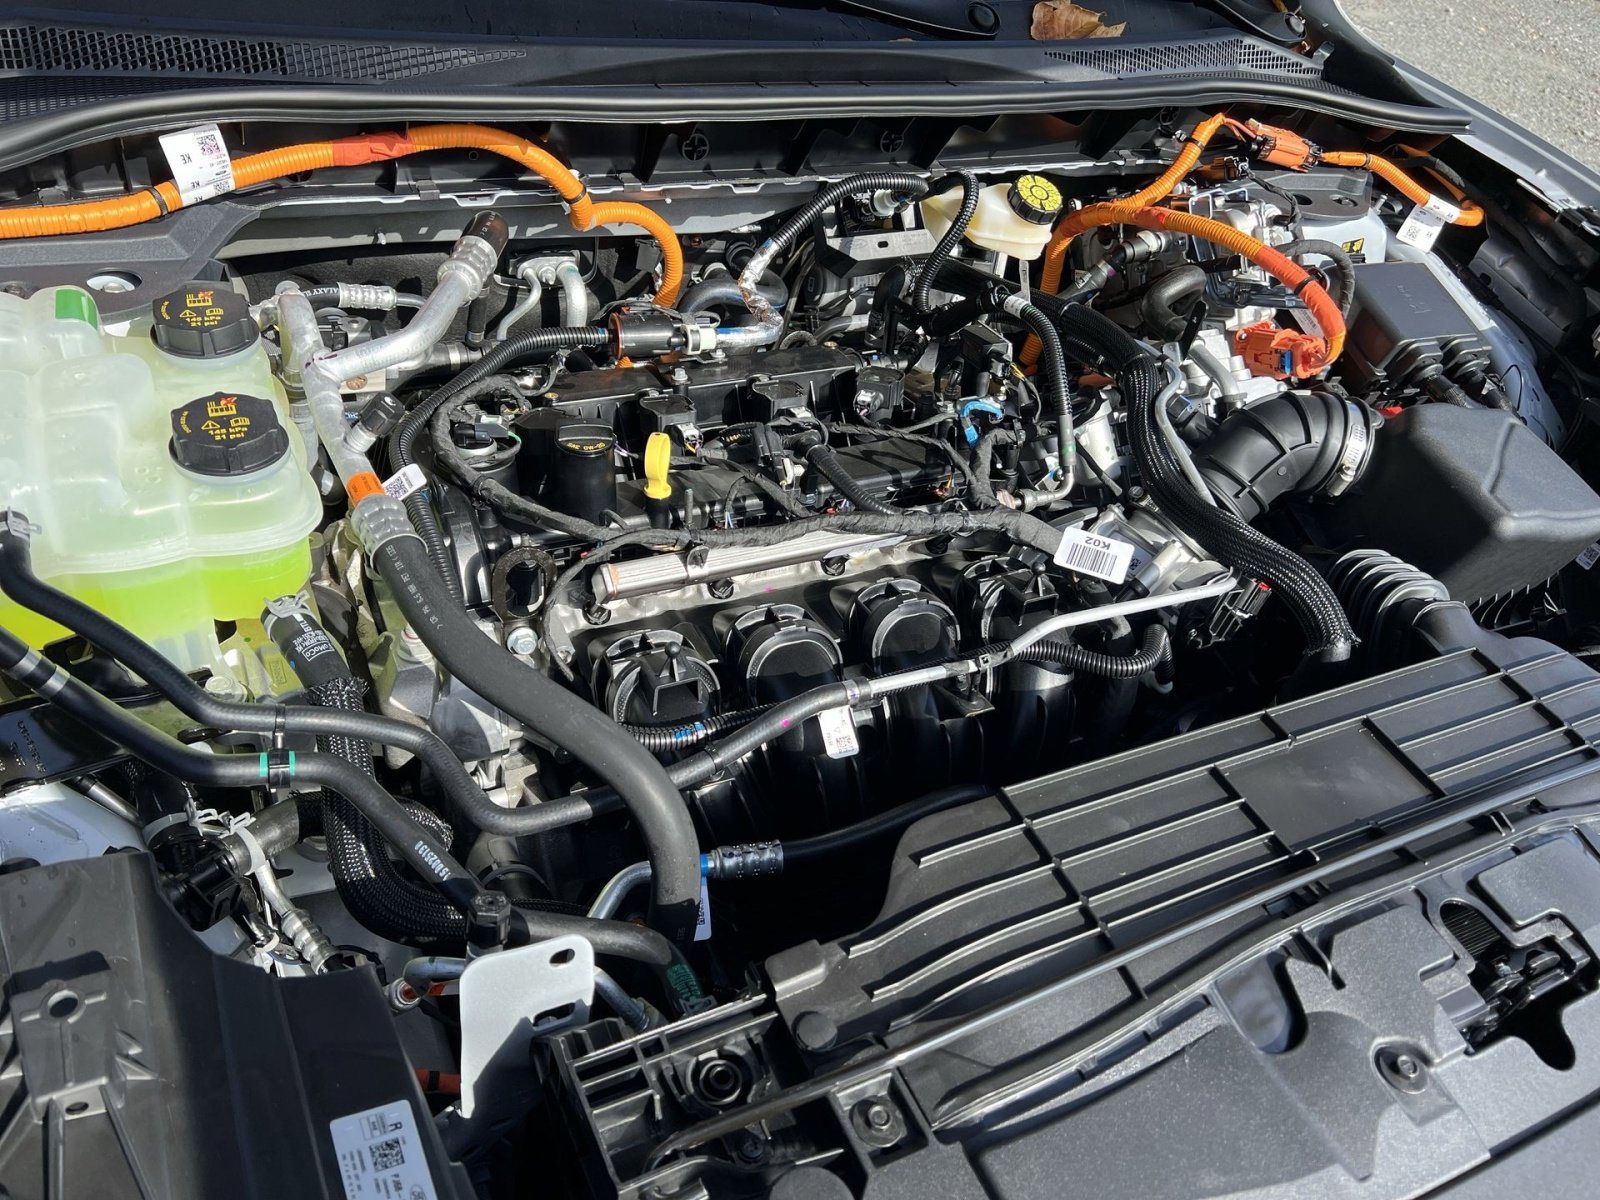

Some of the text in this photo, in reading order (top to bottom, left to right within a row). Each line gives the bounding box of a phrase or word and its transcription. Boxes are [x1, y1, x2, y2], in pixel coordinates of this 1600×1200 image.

[180, 153, 192, 165] KE
[313, 286, 338, 296] ALAXY
[230, 432, 244, 440] psi
[1085, 536, 1111, 550] K02
[387, 1121, 402, 1132] R
